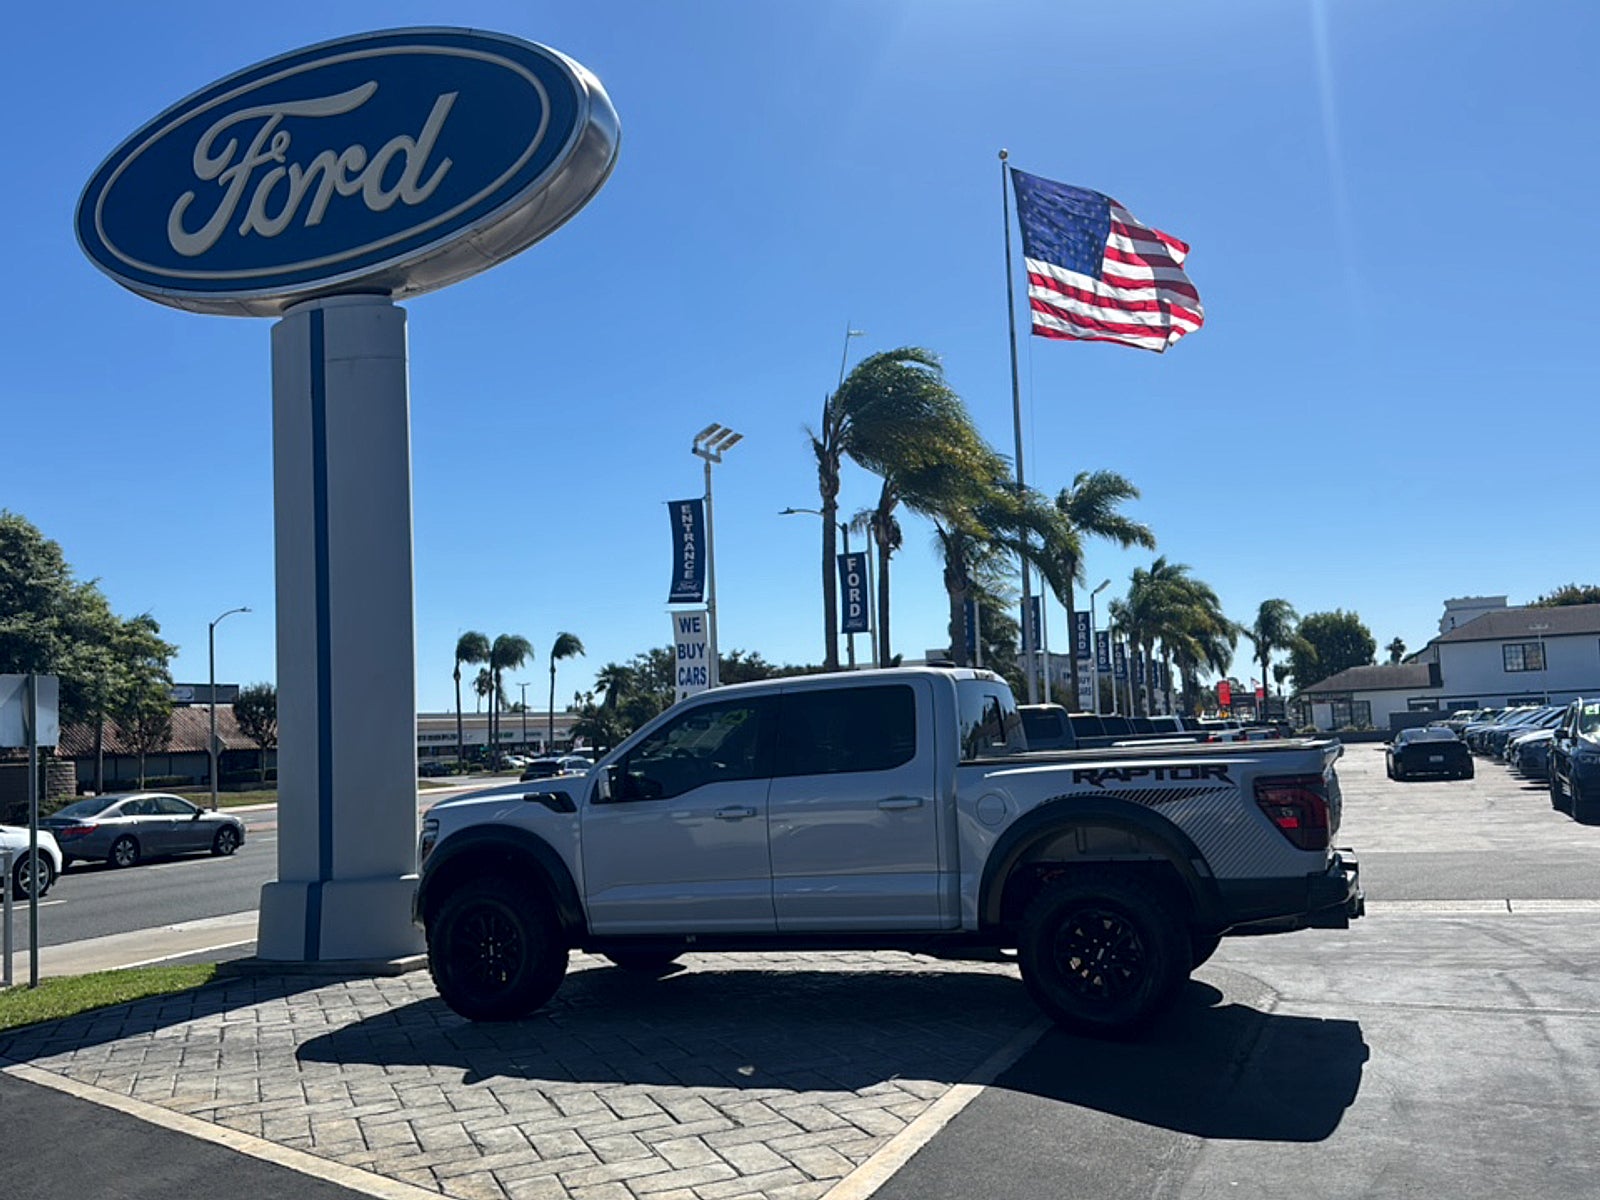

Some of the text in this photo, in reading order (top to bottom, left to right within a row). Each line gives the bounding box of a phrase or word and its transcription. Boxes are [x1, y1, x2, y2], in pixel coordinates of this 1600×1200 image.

[167, 80, 459, 257] Ford
[681, 504, 695, 579] ENTRANCE
[846, 558, 861, 618] FORD
[679, 617, 701, 633] WE
[1078, 613, 1087, 650] FORD
[677, 643, 705, 659] BUY
[678, 666, 707, 686] CARS
[1072, 764, 1237, 789] RAPTOR
